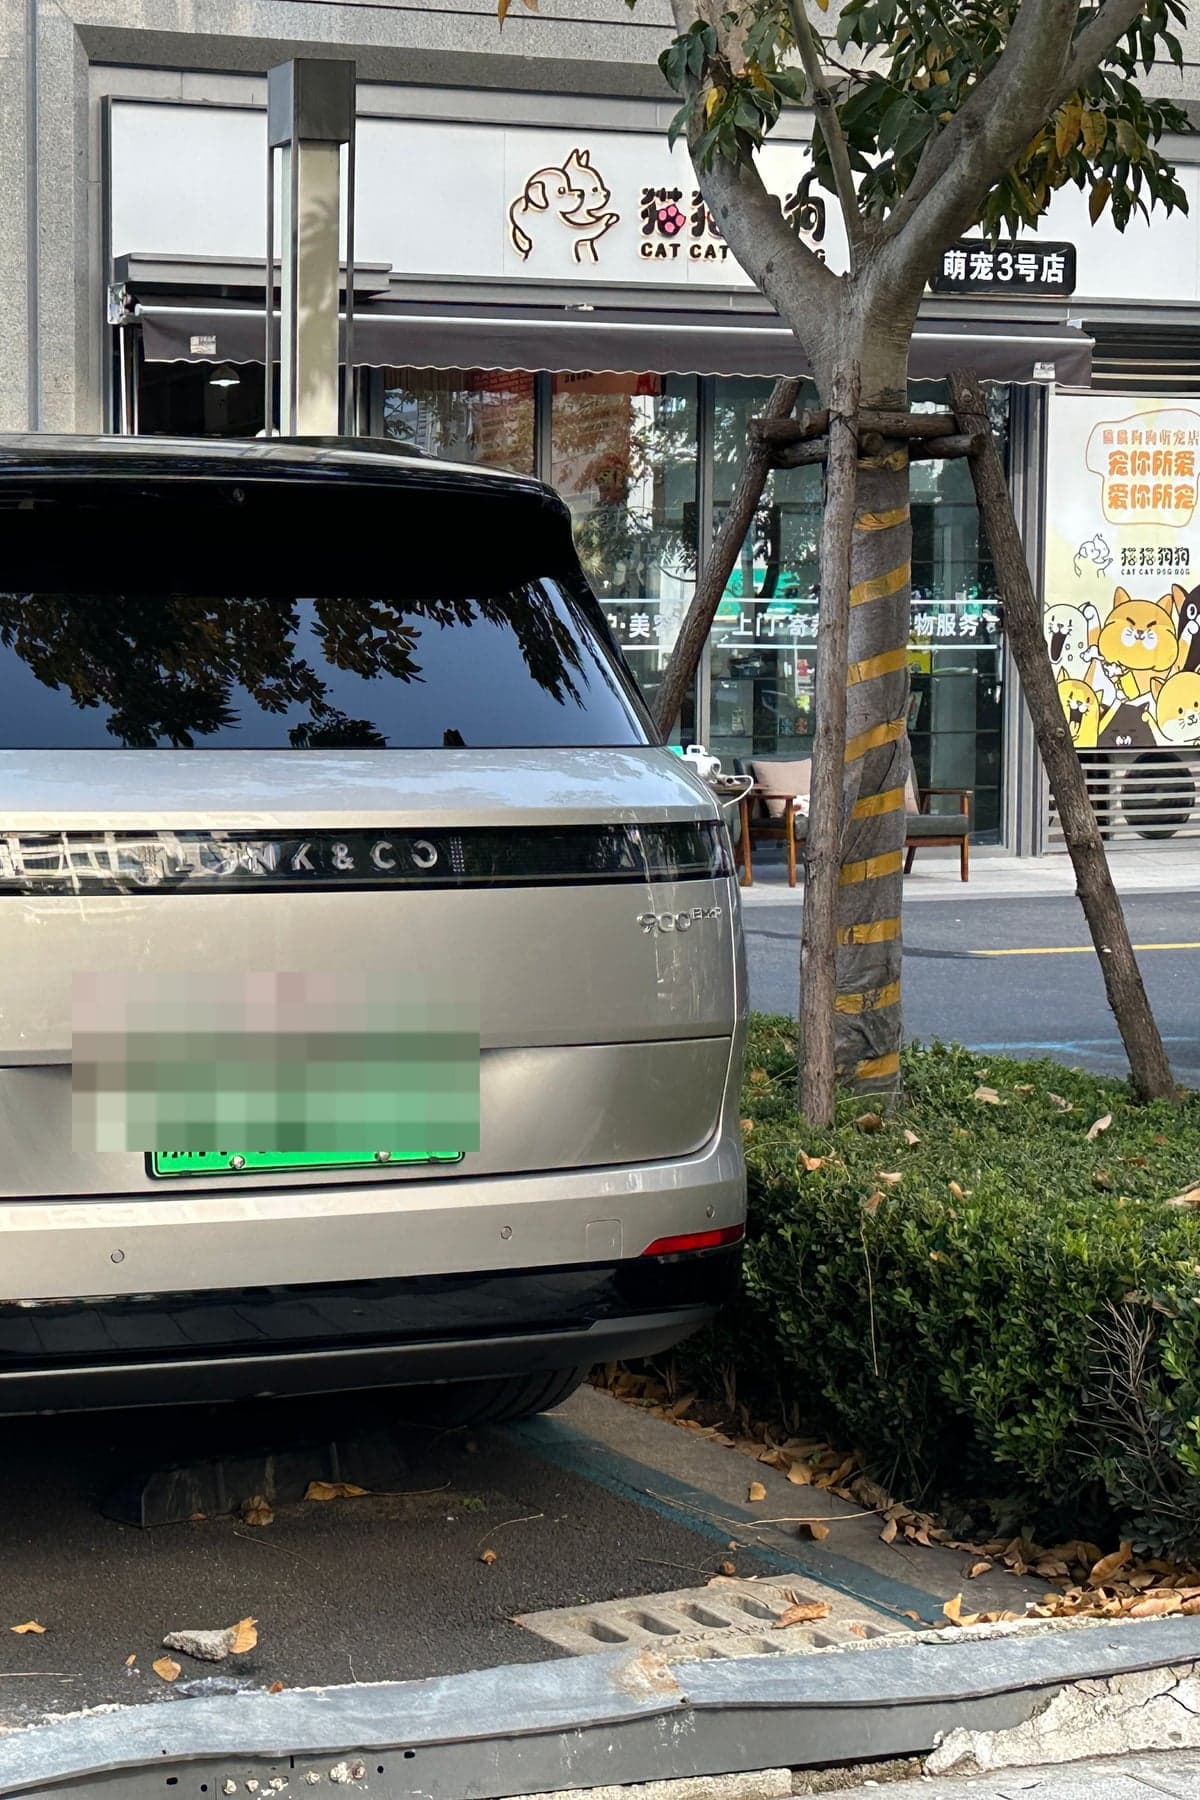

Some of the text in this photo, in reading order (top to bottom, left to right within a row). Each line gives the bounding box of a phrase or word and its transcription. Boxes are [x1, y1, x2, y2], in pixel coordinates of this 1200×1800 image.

[641, 242, 729, 261] CAT CAT
[943, 250, 1065, 283] 萌宠3号店
[1108, 450, 1195, 477] 宠你所爱
[1108, 483, 1195, 510] 爱你所宠
[1120, 568, 1136, 576] CAT
[1138, 568, 1154, 576] CAT
[908, 612, 979, 637] 物服务
